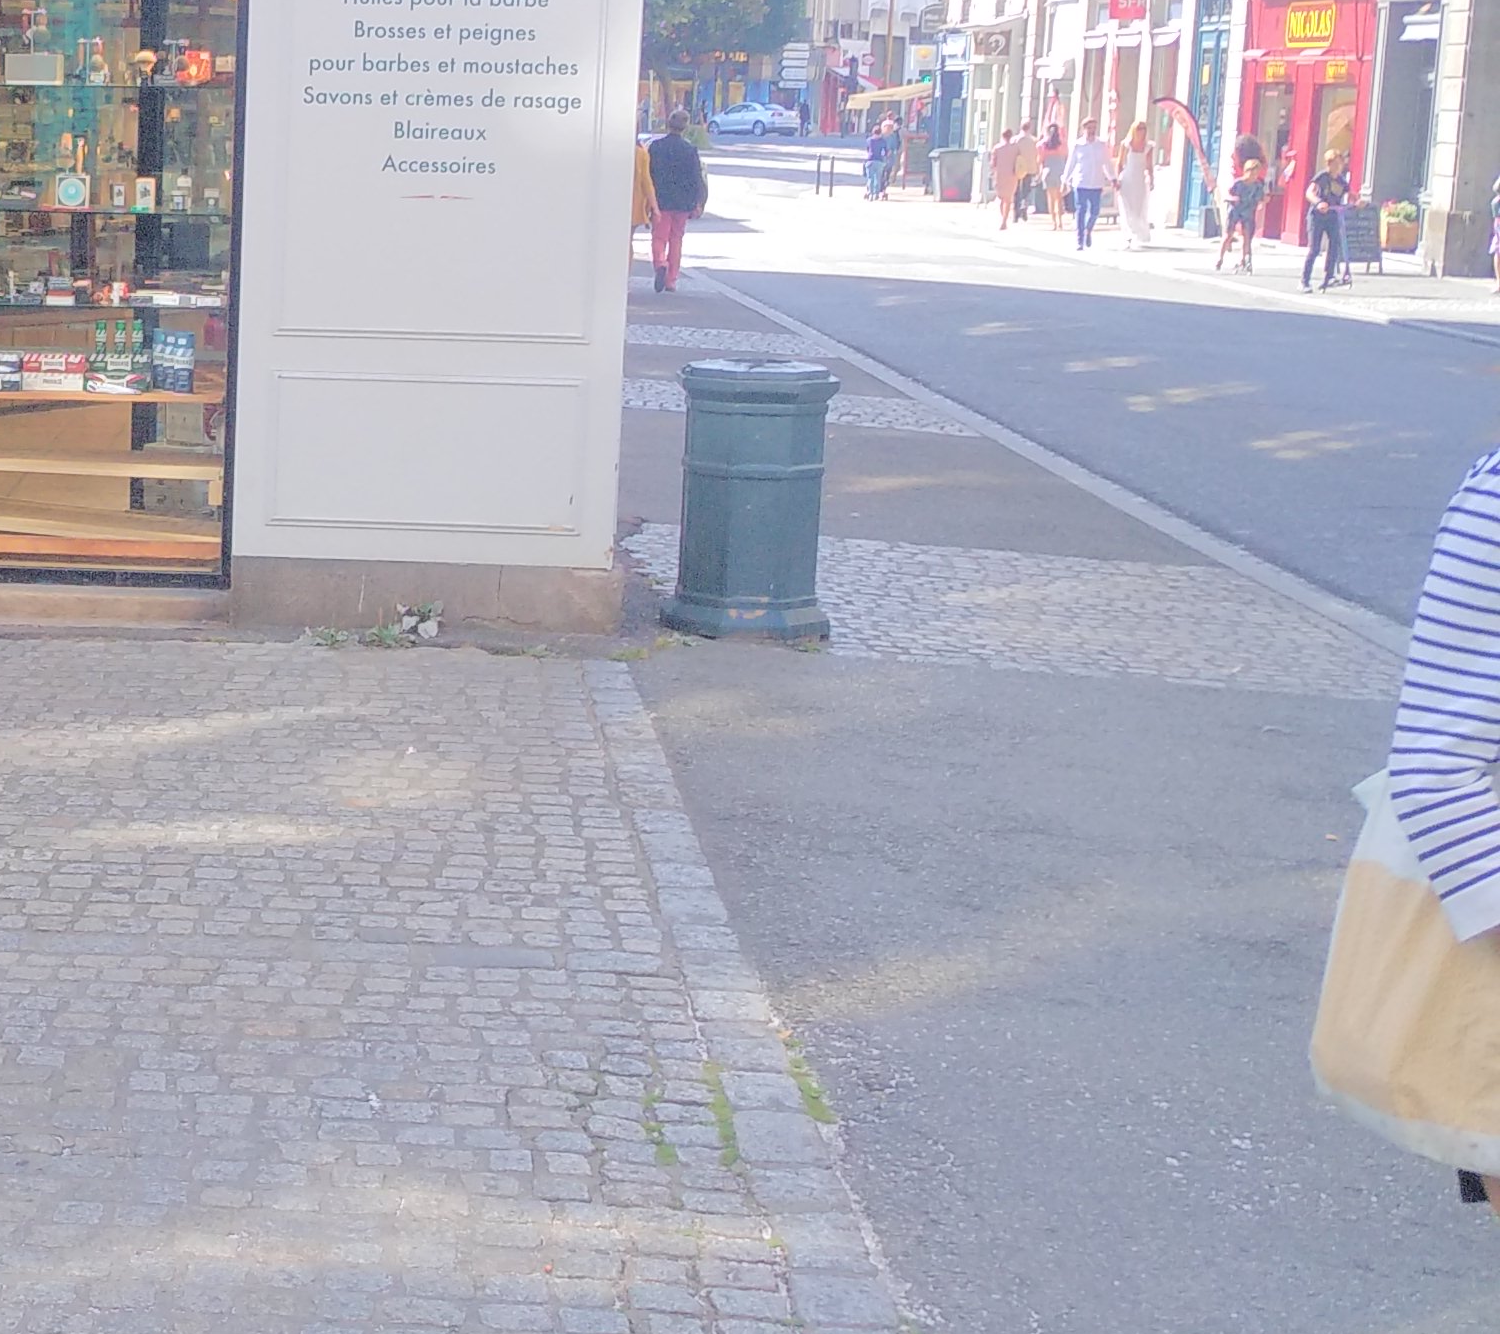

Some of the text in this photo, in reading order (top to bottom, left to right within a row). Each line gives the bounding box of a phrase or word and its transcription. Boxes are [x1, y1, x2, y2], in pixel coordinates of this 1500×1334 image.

[354, 21, 536, 45] Brosses et peignes
[1288, 9, 1332, 38] NICOLAS
[309, 53, 578, 76] pour barbes et moustaches
[303, 86, 582, 114] Savons et crèmes de rasage
[394, 120, 487, 140] Blaireaux
[382, 155, 496, 174] Accessoires
